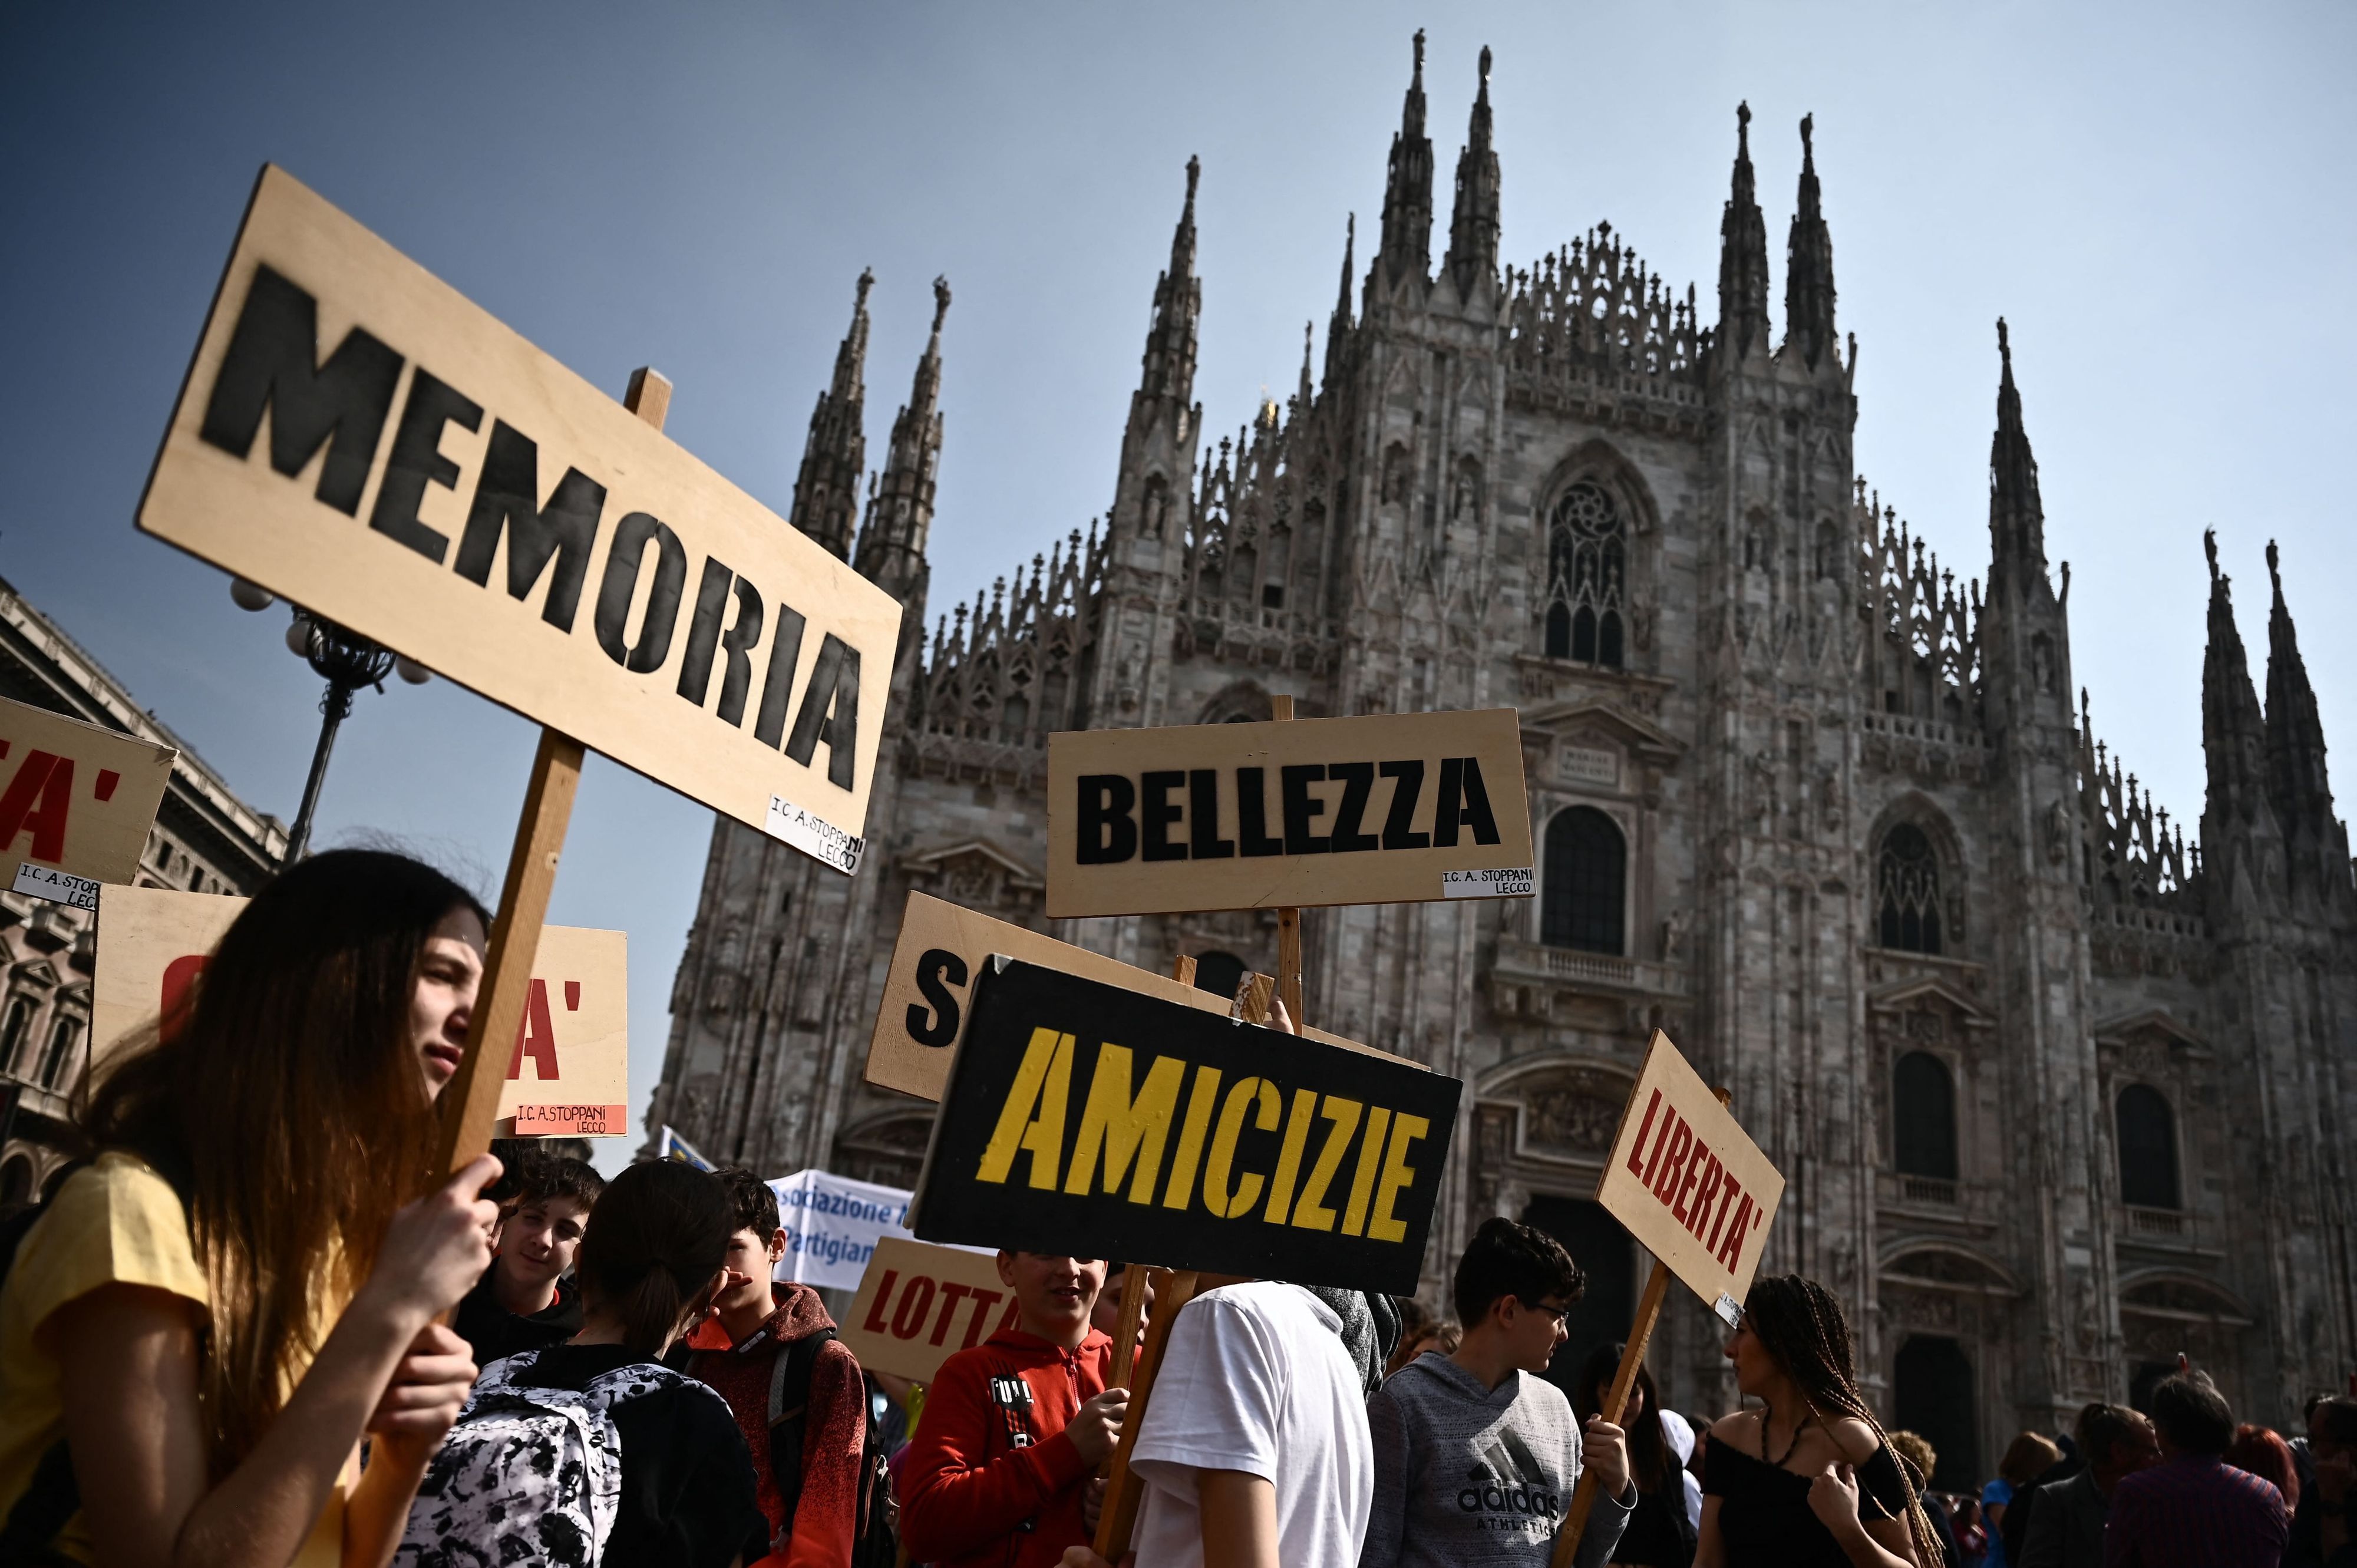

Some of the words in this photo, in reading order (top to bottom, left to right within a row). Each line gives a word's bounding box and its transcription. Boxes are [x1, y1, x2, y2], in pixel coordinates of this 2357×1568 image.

[199, 262, 862, 794] MEMORIA
[0, 738, 120, 864] A'
[1076, 757, 1501, 865] BELLEZZA
[818, 840, 856, 870] LECCO
[21, 865, 41, 880] I.C.
[1443, 872, 1461, 883] I.C.
[1464, 871, 1477, 882] A.
[1481, 869, 1533, 882] STOPPANI
[67, 890, 95, 908] LEC
[1496, 882, 1531, 894] LECCO
[906, 949, 981, 1048] S
[518, 1105, 535, 1121] I.C.
[577, 1122, 606, 1133] LECCO
[976, 1026, 1430, 1243] AMICIZIE
[1627, 1087, 1764, 1276] LIBERTA'
[1457, 1480, 1559, 1521] adidas
[1477, 1518, 1556, 1539] ATHLETICS
